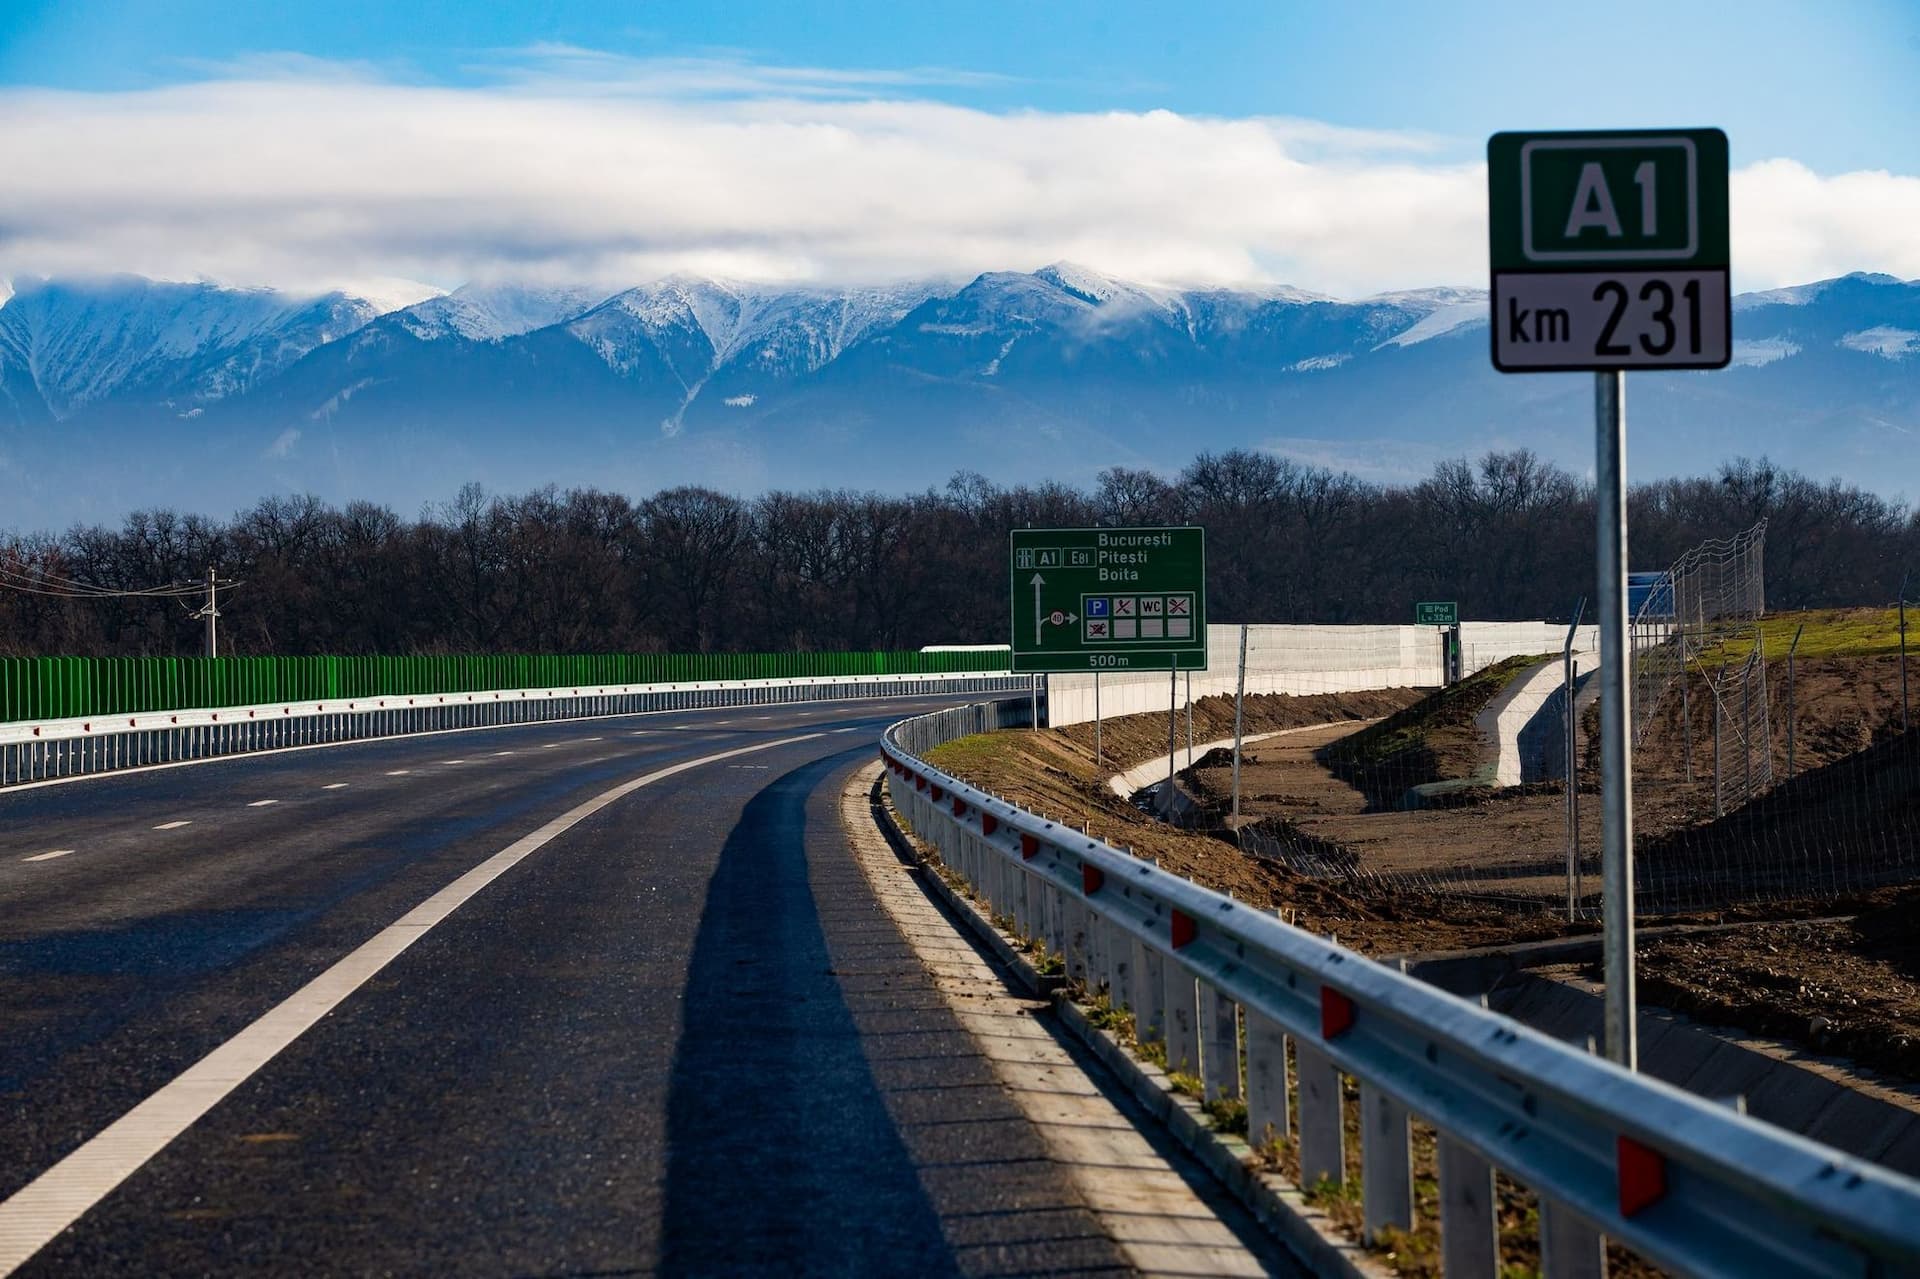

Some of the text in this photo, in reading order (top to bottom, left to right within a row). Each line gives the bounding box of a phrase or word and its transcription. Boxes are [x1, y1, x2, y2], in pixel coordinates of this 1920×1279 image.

[1564, 161, 1657, 237] A1
[1509, 280, 1702, 356] km 231
[1098, 532, 1172, 548] București
[1040, 552, 1056, 565] A1
[1071, 551, 1089, 565] E81
[1092, 601, 1103, 615] P
[1142, 600, 1161, 612] WC
[1052, 613, 1063, 622] 40
